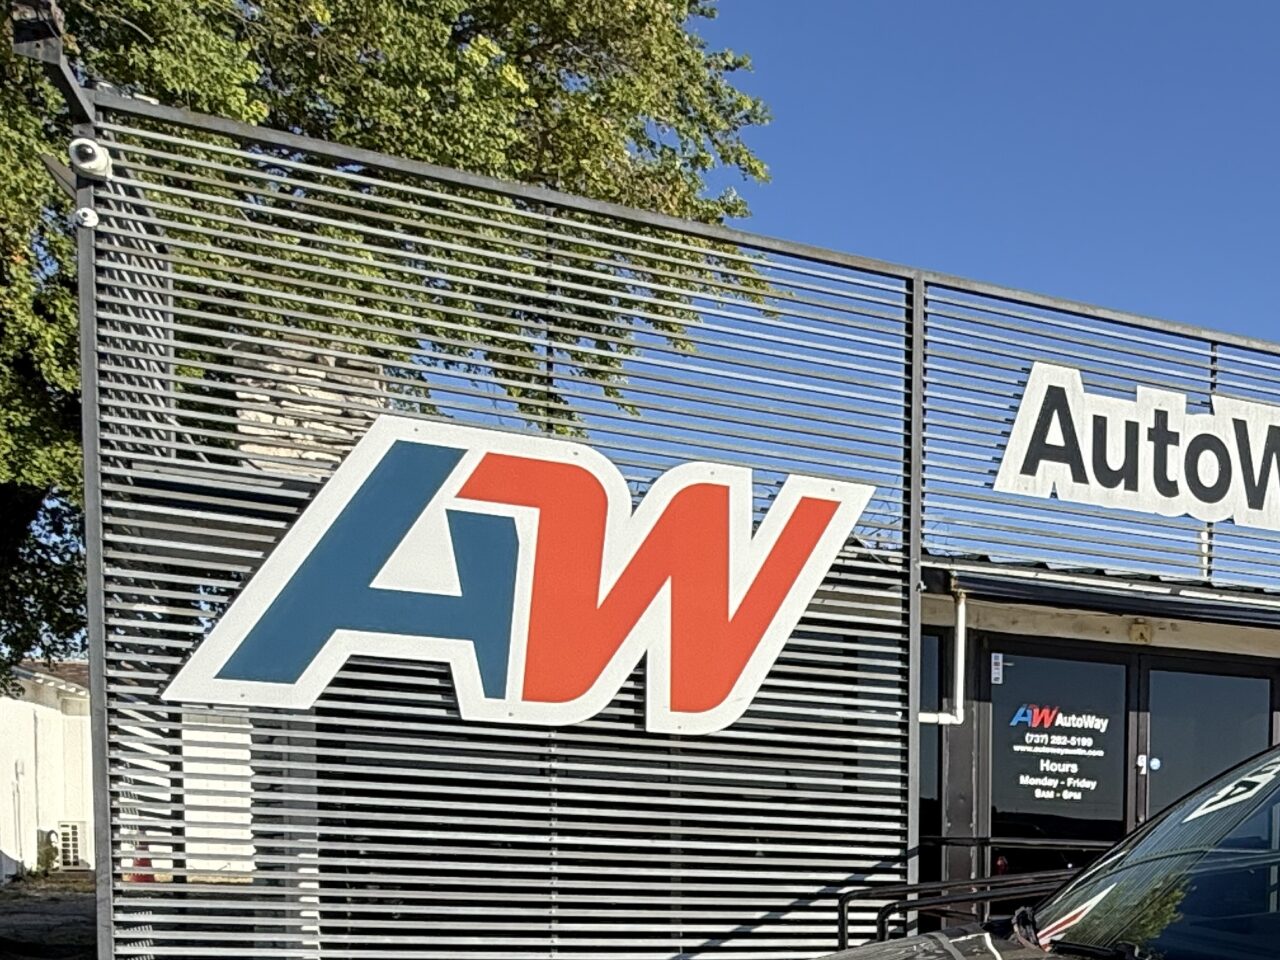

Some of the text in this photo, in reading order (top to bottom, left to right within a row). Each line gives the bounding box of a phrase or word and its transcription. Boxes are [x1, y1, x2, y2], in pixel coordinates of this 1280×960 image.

[213, 438, 843, 714] AW
[1009, 703, 1109, 733] AW AutoWay
[1024, 732, 1049, 746] (737)
[1039, 758, 1079, 774] Hours
[1019, 774, 1060, 789] Monday
[1066, 777, 1098, 791] Friday
